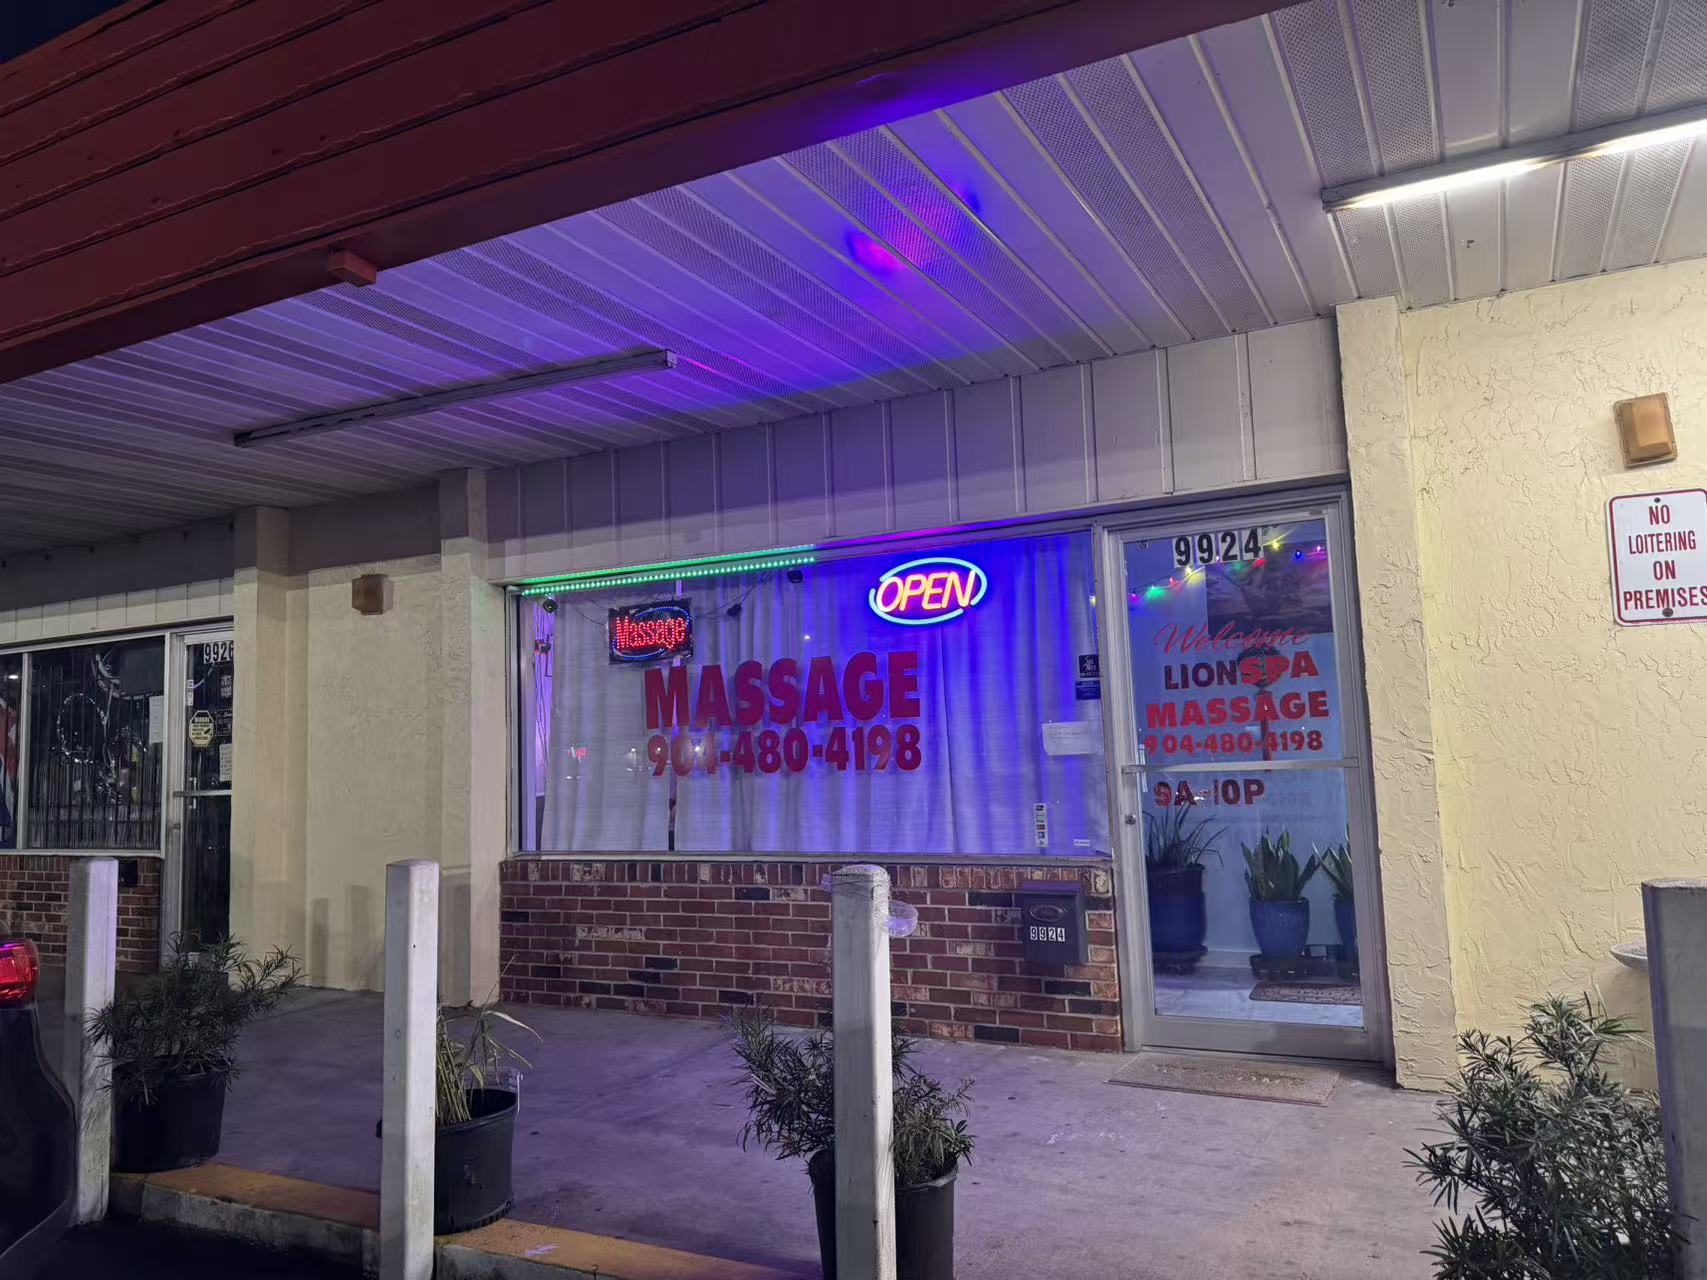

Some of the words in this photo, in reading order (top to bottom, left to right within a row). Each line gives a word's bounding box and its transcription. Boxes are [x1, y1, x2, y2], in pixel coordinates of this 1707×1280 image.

[1648, 504, 1671, 525] NO
[1174, 528, 1262, 567] 9924
[1628, 530, 1697, 555] LOITERING
[1652, 559, 1677, 581] ON
[876, 569, 976, 613] OPEN
[1622, 585, 1707, 611] PREMISES
[616, 615, 688, 649] Massage
[1153, 620, 1313, 657] Welcome
[204, 640, 234, 663] 9926
[1164, 659, 1238, 690] LION
[643, 651, 921, 730] MASSAGE
[1146, 690, 1330, 729] MASSAGE
[647, 723, 922, 777] 904-480-4198
[1143, 729, 1324, 757] 904-480-4198
[1030, 926, 1066, 942] 9924
